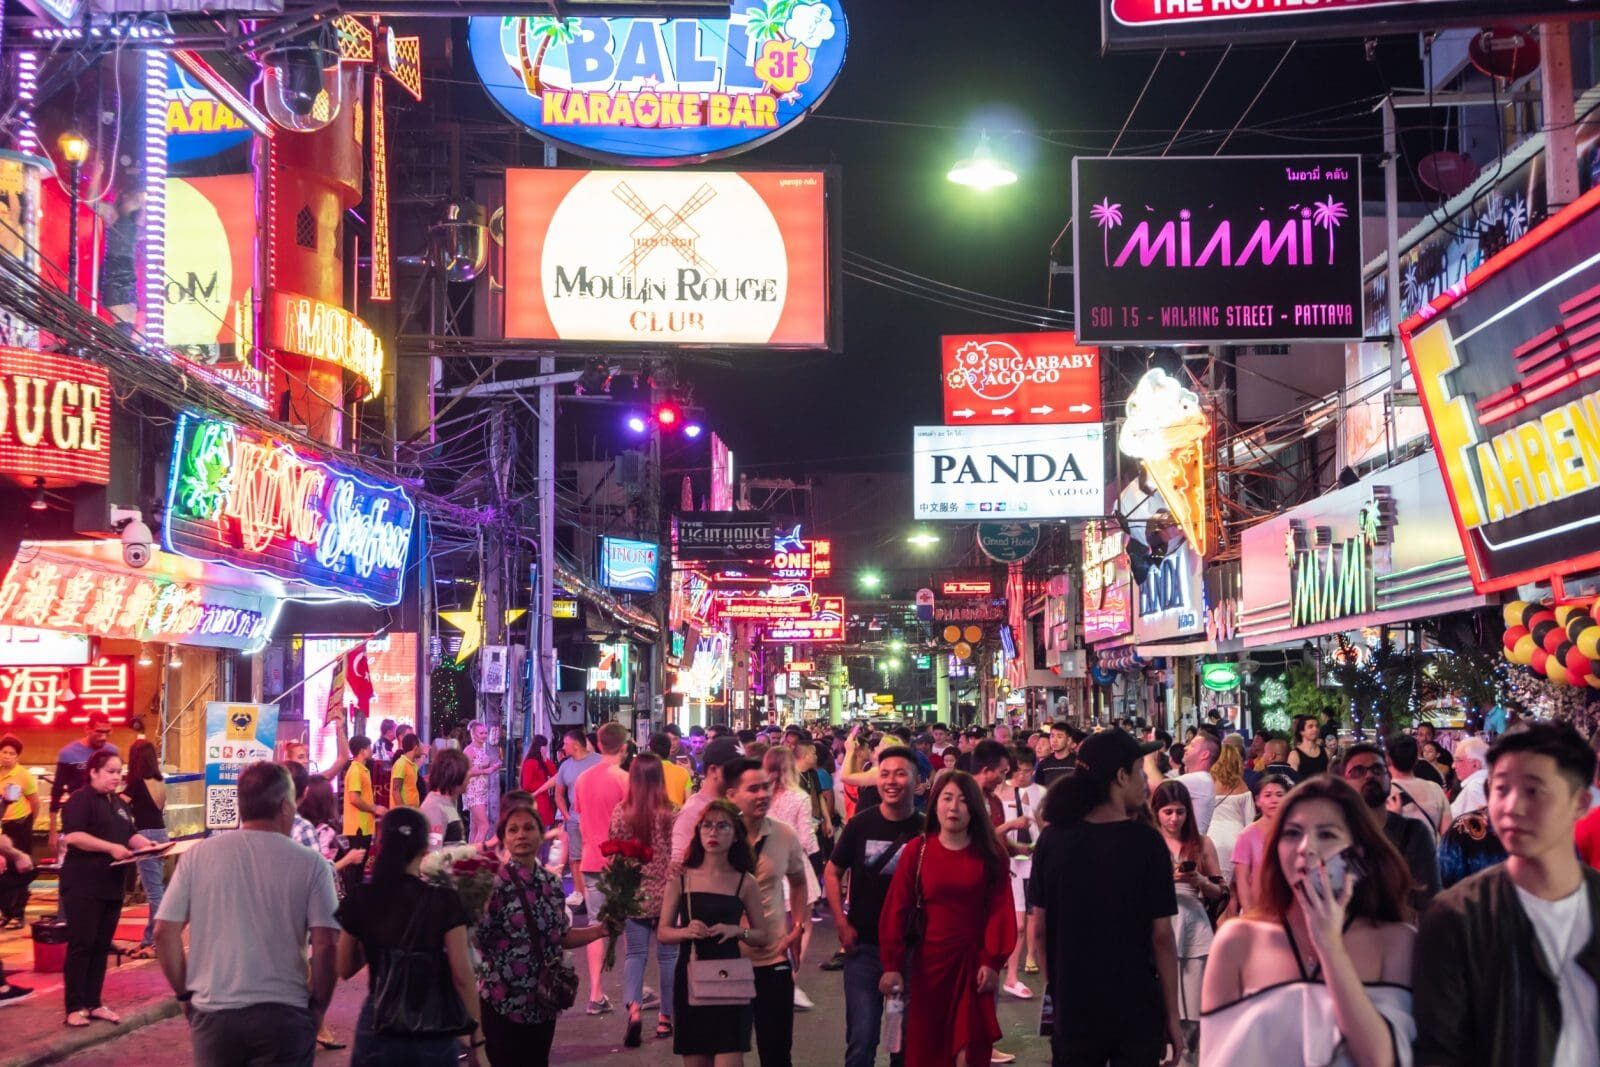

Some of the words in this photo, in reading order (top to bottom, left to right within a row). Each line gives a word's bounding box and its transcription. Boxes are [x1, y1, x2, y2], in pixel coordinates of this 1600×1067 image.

[768, 51, 799, 78] 3F
[542, 92, 702, 127] KARAOKE
[708, 92, 778, 128] BAR
[1325, 168, 1349, 181] คลับ
[554, 265, 666, 303] MOULIN
[676, 268, 777, 302] ROUGE
[629, 310, 704, 332] CLUB
[1092, 307, 1112, 327] SOI
[1122, 307, 1138, 327] 15
[1161, 306, 1219, 326] WALKING
[1226, 305, 1273, 326] STREET
[1294, 304, 1353, 325] PATTAYA
[989, 354, 1095, 371] SUGARBABY
[0, 376, 101, 451] UGE
[930, 453, 1088, 484] PANDA
[920, 502, 959, 513] 中文服务
[983, 536, 1009, 546] Grand
[1011, 535, 1034, 547] Hotel
